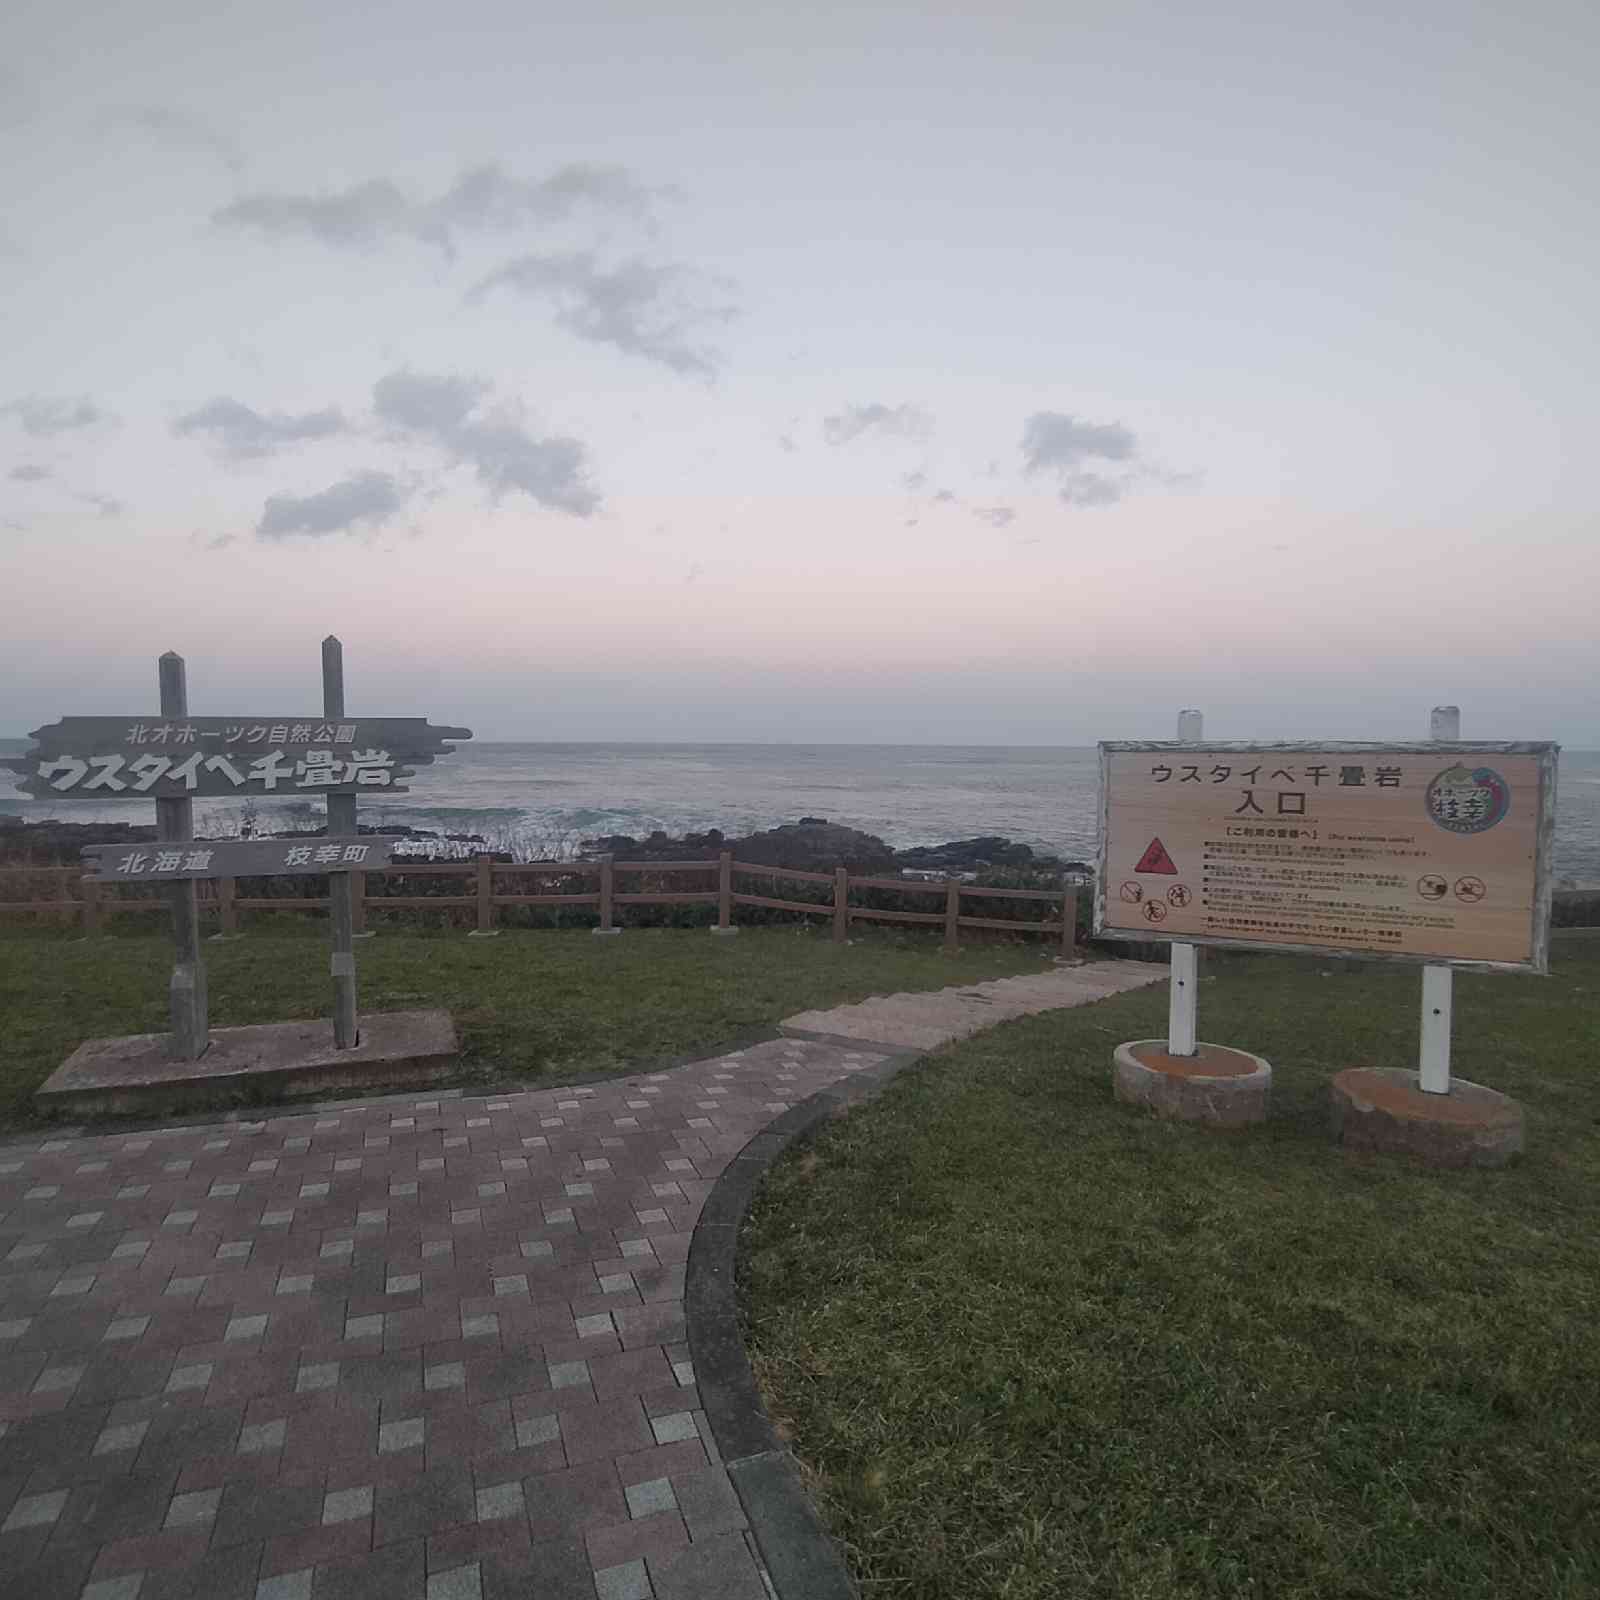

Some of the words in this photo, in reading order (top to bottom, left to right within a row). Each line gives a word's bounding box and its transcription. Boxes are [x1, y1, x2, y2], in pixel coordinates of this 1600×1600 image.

[124, 723, 357, 745] 北オホーツク自然公園
[38, 749, 397, 792] ウスタイベ千畳岩
[1151, 763, 1403, 788] ウスタイベ千畳岩
[1234, 789, 1306, 815] 入口
[117, 847, 215, 874] 北海道
[283, 843, 371, 867] 枝幸町
